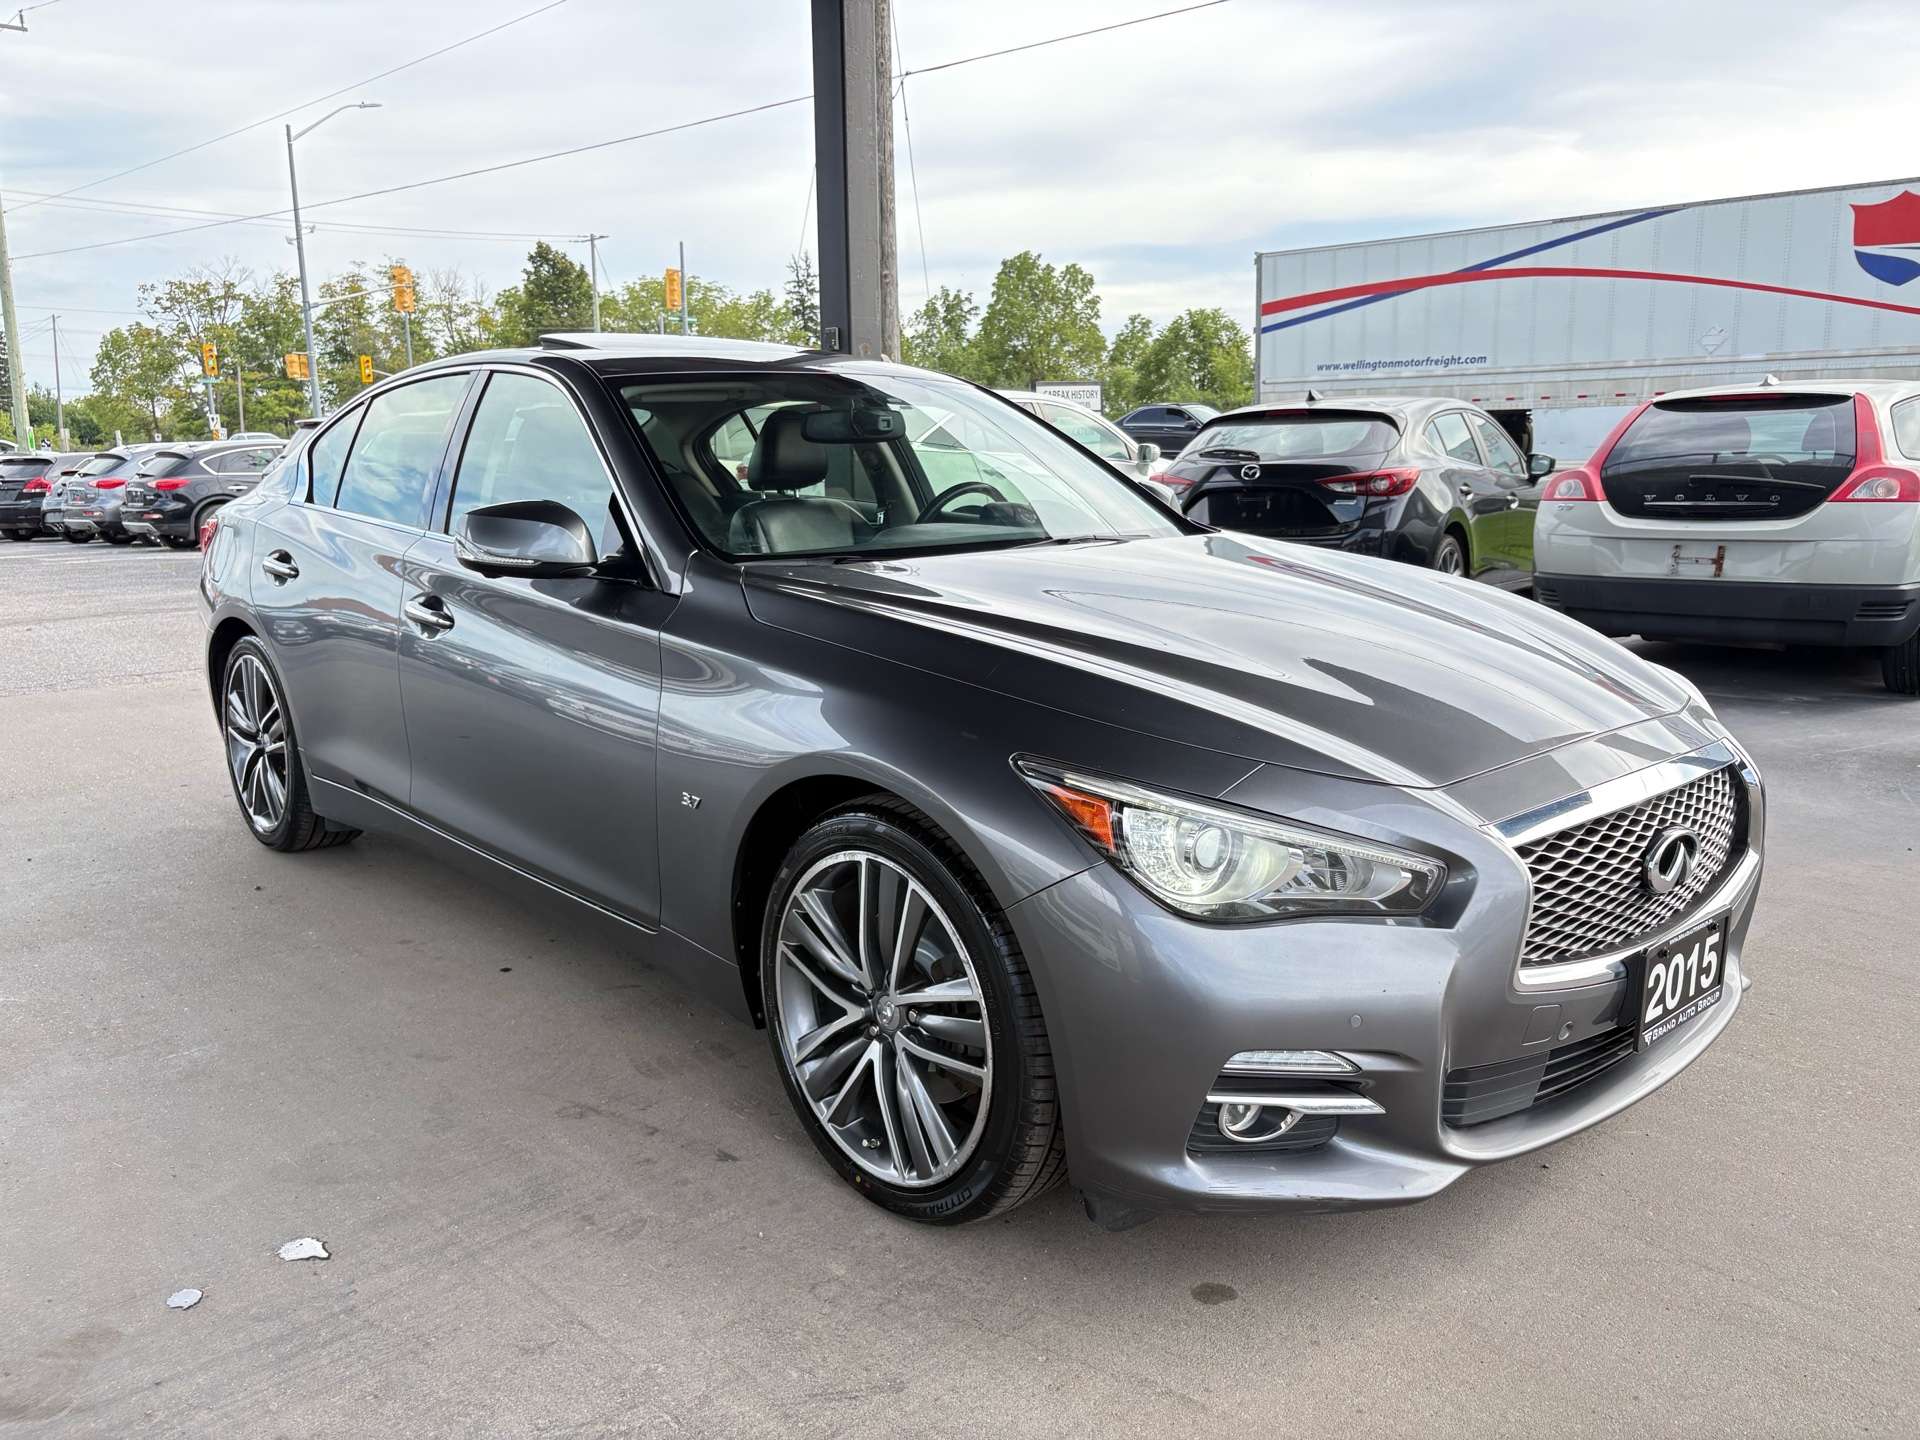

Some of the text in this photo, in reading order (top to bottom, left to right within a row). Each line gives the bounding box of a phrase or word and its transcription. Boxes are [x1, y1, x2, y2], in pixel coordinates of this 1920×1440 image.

[1316, 355, 1488, 372] www.wellingtonmotorfreight.com
[1071, 389, 1099, 400] HISTORY
[1643, 494, 1781, 502] VOLVO
[1644, 932, 1721, 1024] 2015
[1677, 1006, 1697, 1026] AUTO
[1697, 991, 1720, 1013] GROUP
